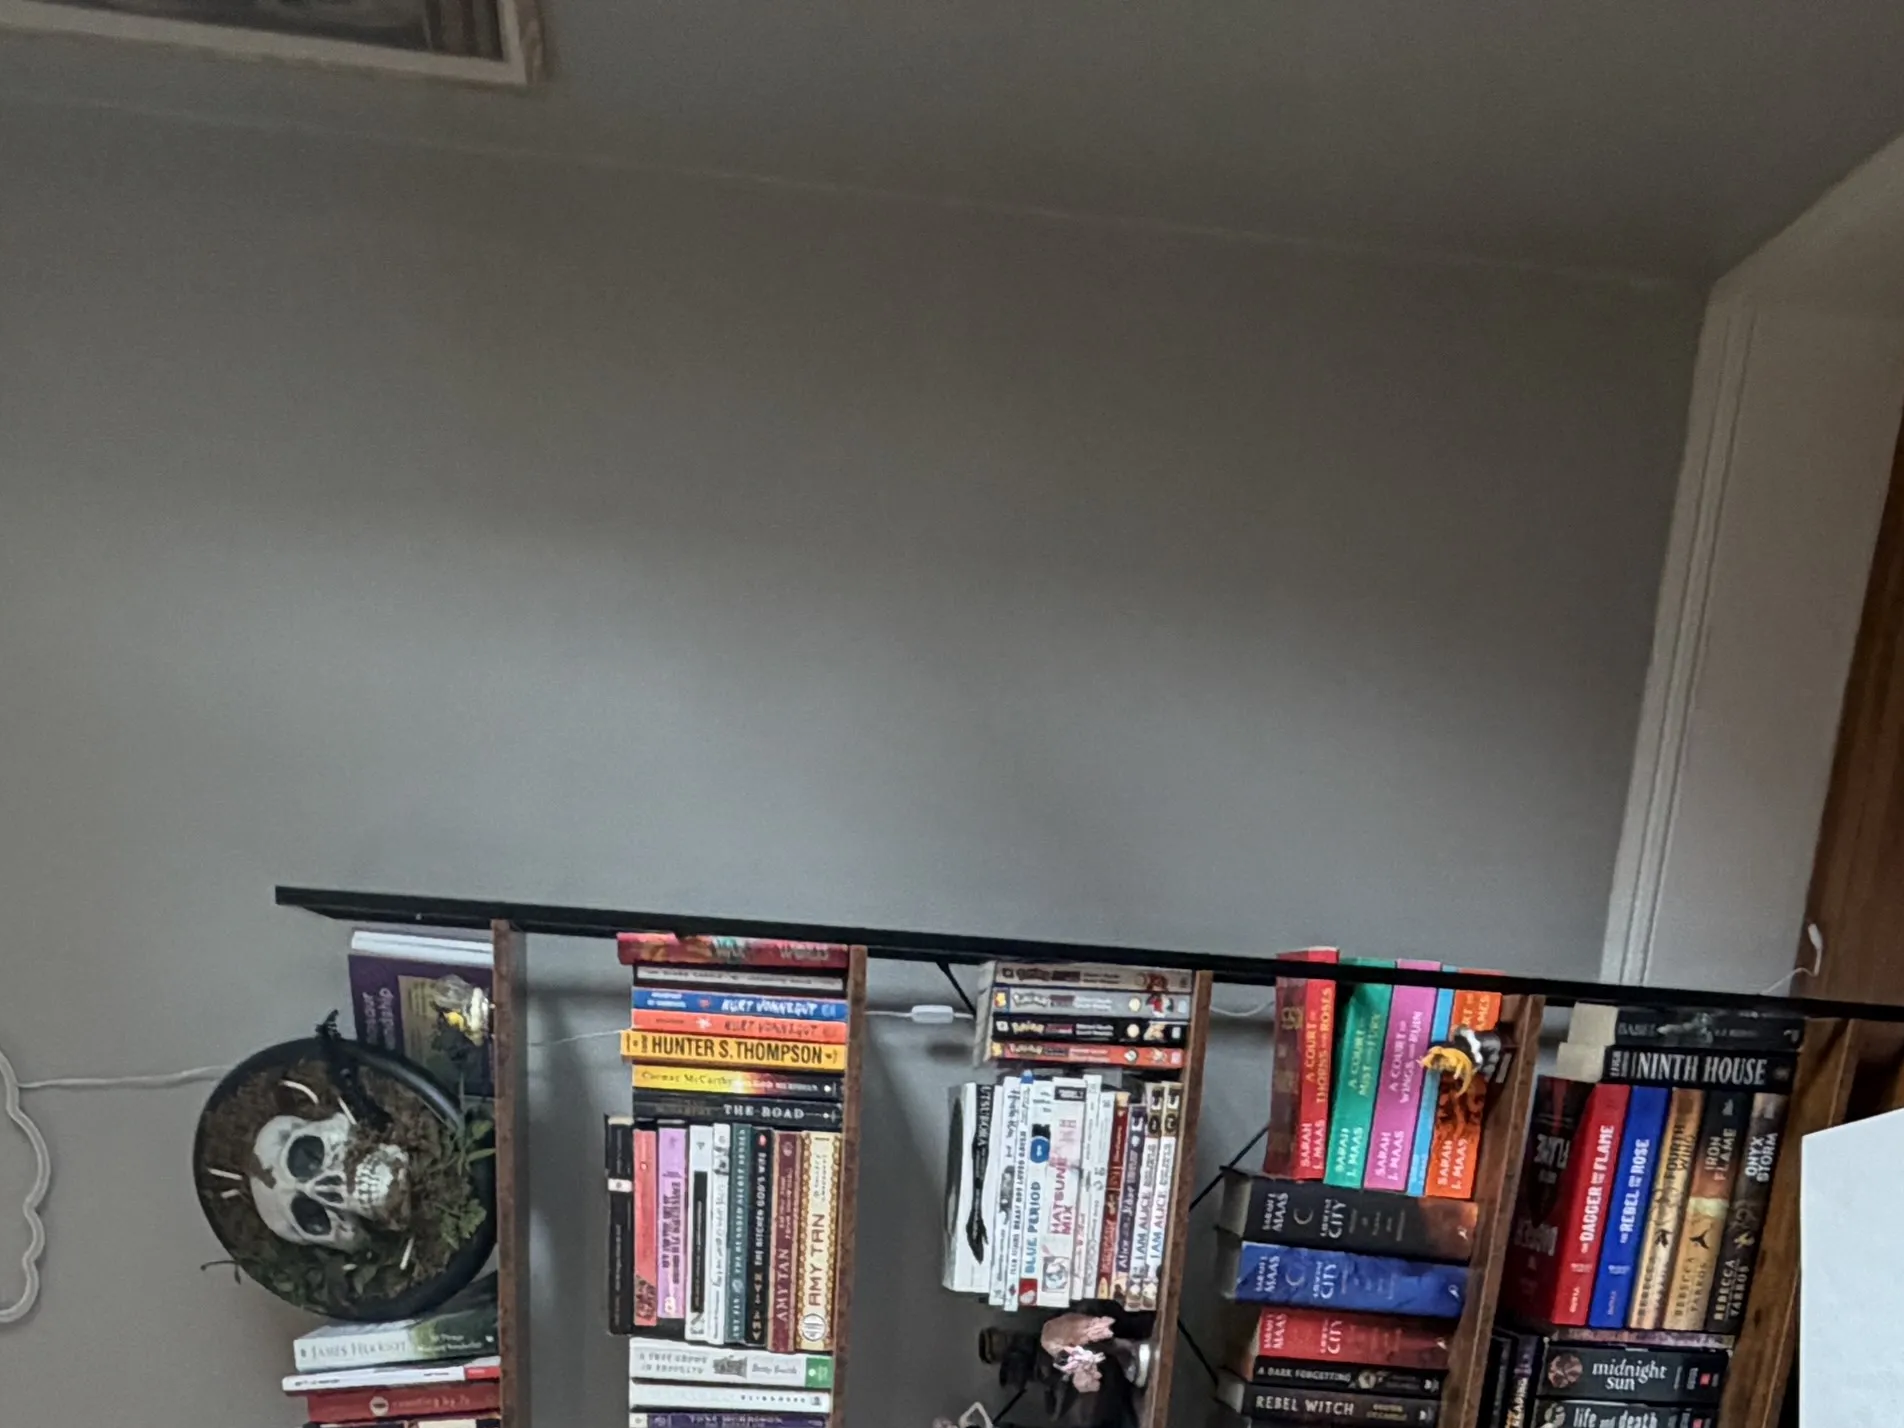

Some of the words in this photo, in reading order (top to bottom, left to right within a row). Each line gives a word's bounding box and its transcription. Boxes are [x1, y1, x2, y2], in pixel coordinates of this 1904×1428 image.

[1320, 987, 1332, 1032] ROSES
[652, 1036, 715, 1057] HUNTER
[719, 1040, 734, 1059] S.
[736, 1043, 822, 1064] THOMPSON
[1306, 1023, 1317, 1068] COURT
[1351, 1029, 1365, 1072] COURT
[1391, 1033, 1406, 1074] COURT
[1317, 1051, 1330, 1103] THORNS
[1399, 1063, 1415, 1103] WINGS
[1635, 1051, 1698, 1079] NINTH
[1703, 1057, 1768, 1085] HOUSE
[724, 1104, 754, 1116] THE
[762, 1105, 805, 1119] ROAD
[1300, 1122, 1312, 1168] SARAH
[1313, 1119, 1326, 1157] MAAS
[1335, 1128, 1349, 1172] SARAH
[1349, 1128, 1363, 1163] MAAS
[1375, 1132, 1391, 1175] SARAH
[1390, 1131, 1405, 1167] MAAS
[1453, 1138, 1468, 1177] MAAS
[1706, 1136, 1722, 1171] IRON
[1714, 1128, 1737, 1181] FLAME
[1746, 1137, 1764, 1177] ONYX
[1756, 1132, 1778, 1183] STORM
[1437, 1140, 1453, 1185] SARAH
[1580, 1186, 1603, 1242] DAGGER
[1596, 1124, 1615, 1171] FLAME
[1619, 1185, 1640, 1233] REBEL
[1631, 1138, 1650, 1173] ROSE
[1027, 1181, 1041, 1233] PERIOD
[1060, 1205, 1073, 1235] MIX
[1138, 1191, 1151, 1230] ALICE
[1152, 1190, 1166, 1228] ALICE
[1273, 1192, 1288, 1232] MAAS
[1328, 1200, 1346, 1239] CITY
[811, 1213, 826, 1255] TAN
[777, 1248, 791, 1284] TAN
[1024, 1236, 1037, 1274] BLUE
[1264, 1255, 1280, 1293] MAAS
[808, 1264, 823, 1307] AMY
[1320, 1263, 1337, 1299] CITY
[1713, 1258, 1737, 1321] REBECCA
[775, 1284, 788, 1321] AMY
[1272, 1313, 1287, 1349] MAAS
[1327, 1319, 1344, 1355] CITY
[1267, 1368, 1292, 1378] DARK
[1592, 1359, 1668, 1383] midnight
[1605, 1378, 1636, 1391] sun
[1256, 1395, 1299, 1412] REBEL
[1305, 1399, 1354, 1416] WITCH
[1573, 1408, 1597, 1428] life
